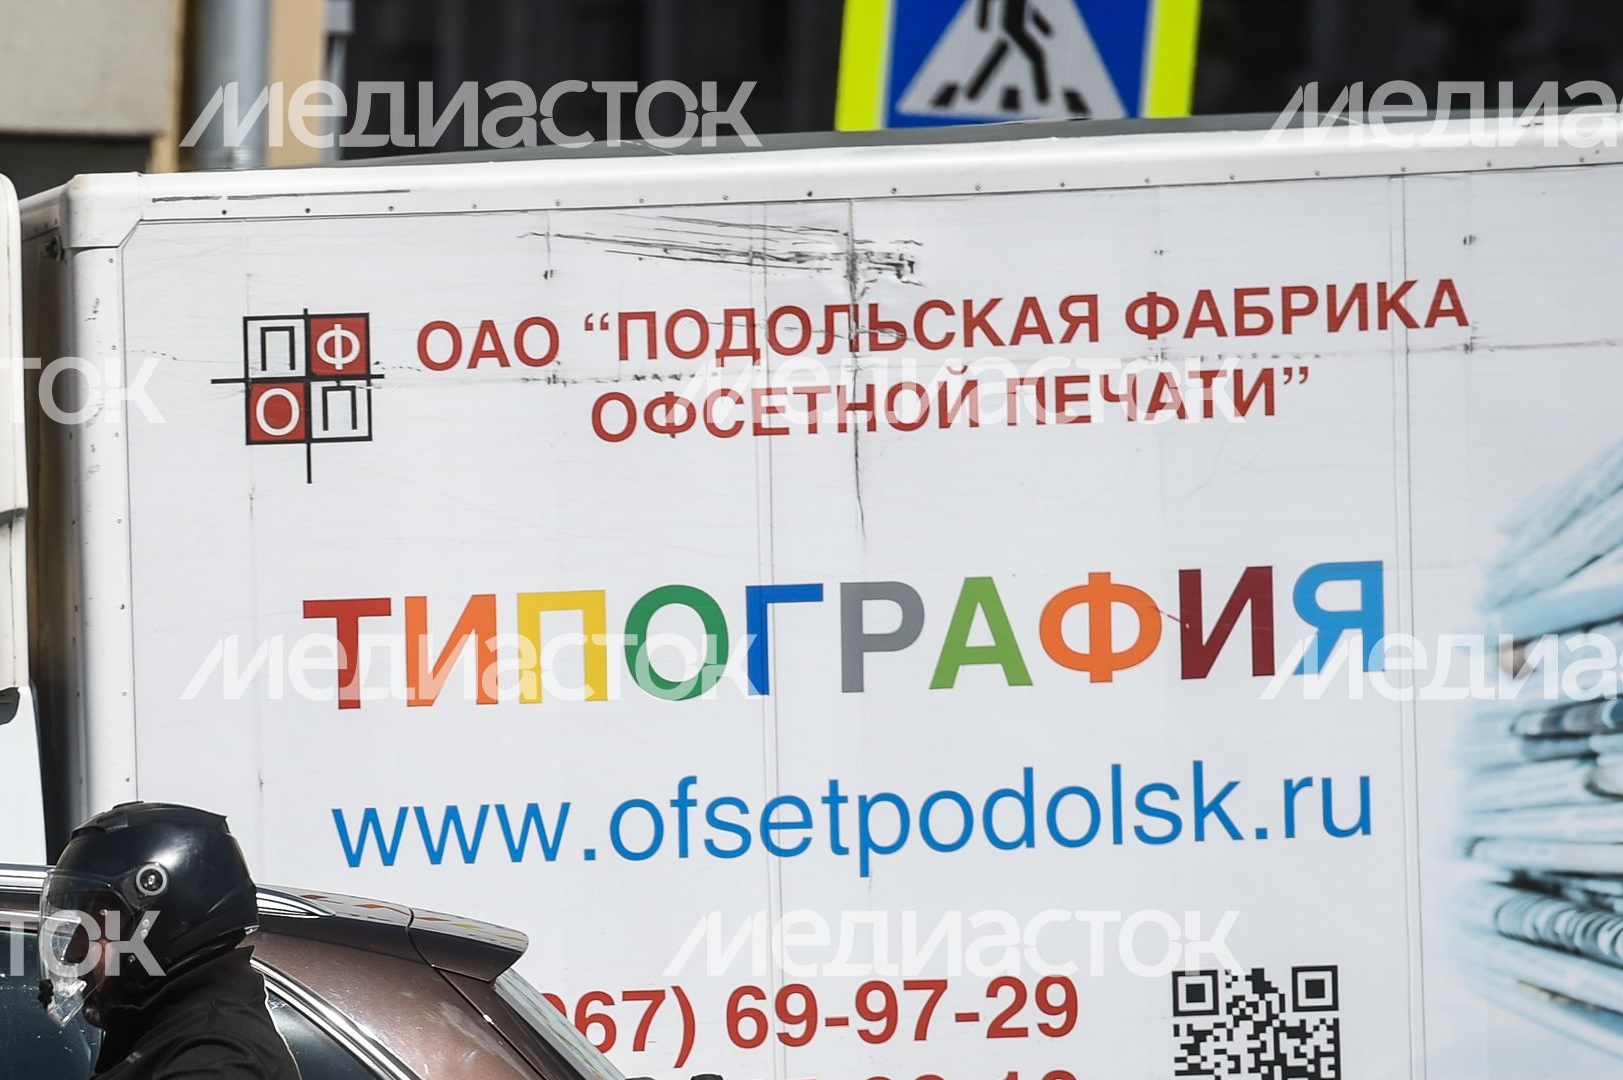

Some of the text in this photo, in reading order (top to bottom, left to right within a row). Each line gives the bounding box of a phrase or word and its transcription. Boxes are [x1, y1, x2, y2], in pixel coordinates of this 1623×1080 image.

[417, 316, 560, 372] ОАО
[1125, 278, 1469, 340] ФАБРИКА
[591, 364, 980, 443] ОФСЕТНОЙ
[302, 560, 1385, 710] ТИПОГРАФИЯ
[331, 759, 1372, 878] www.ofsetpodolsk.ru
[540, 975, 1079, 1069] 67) 69-97-29
